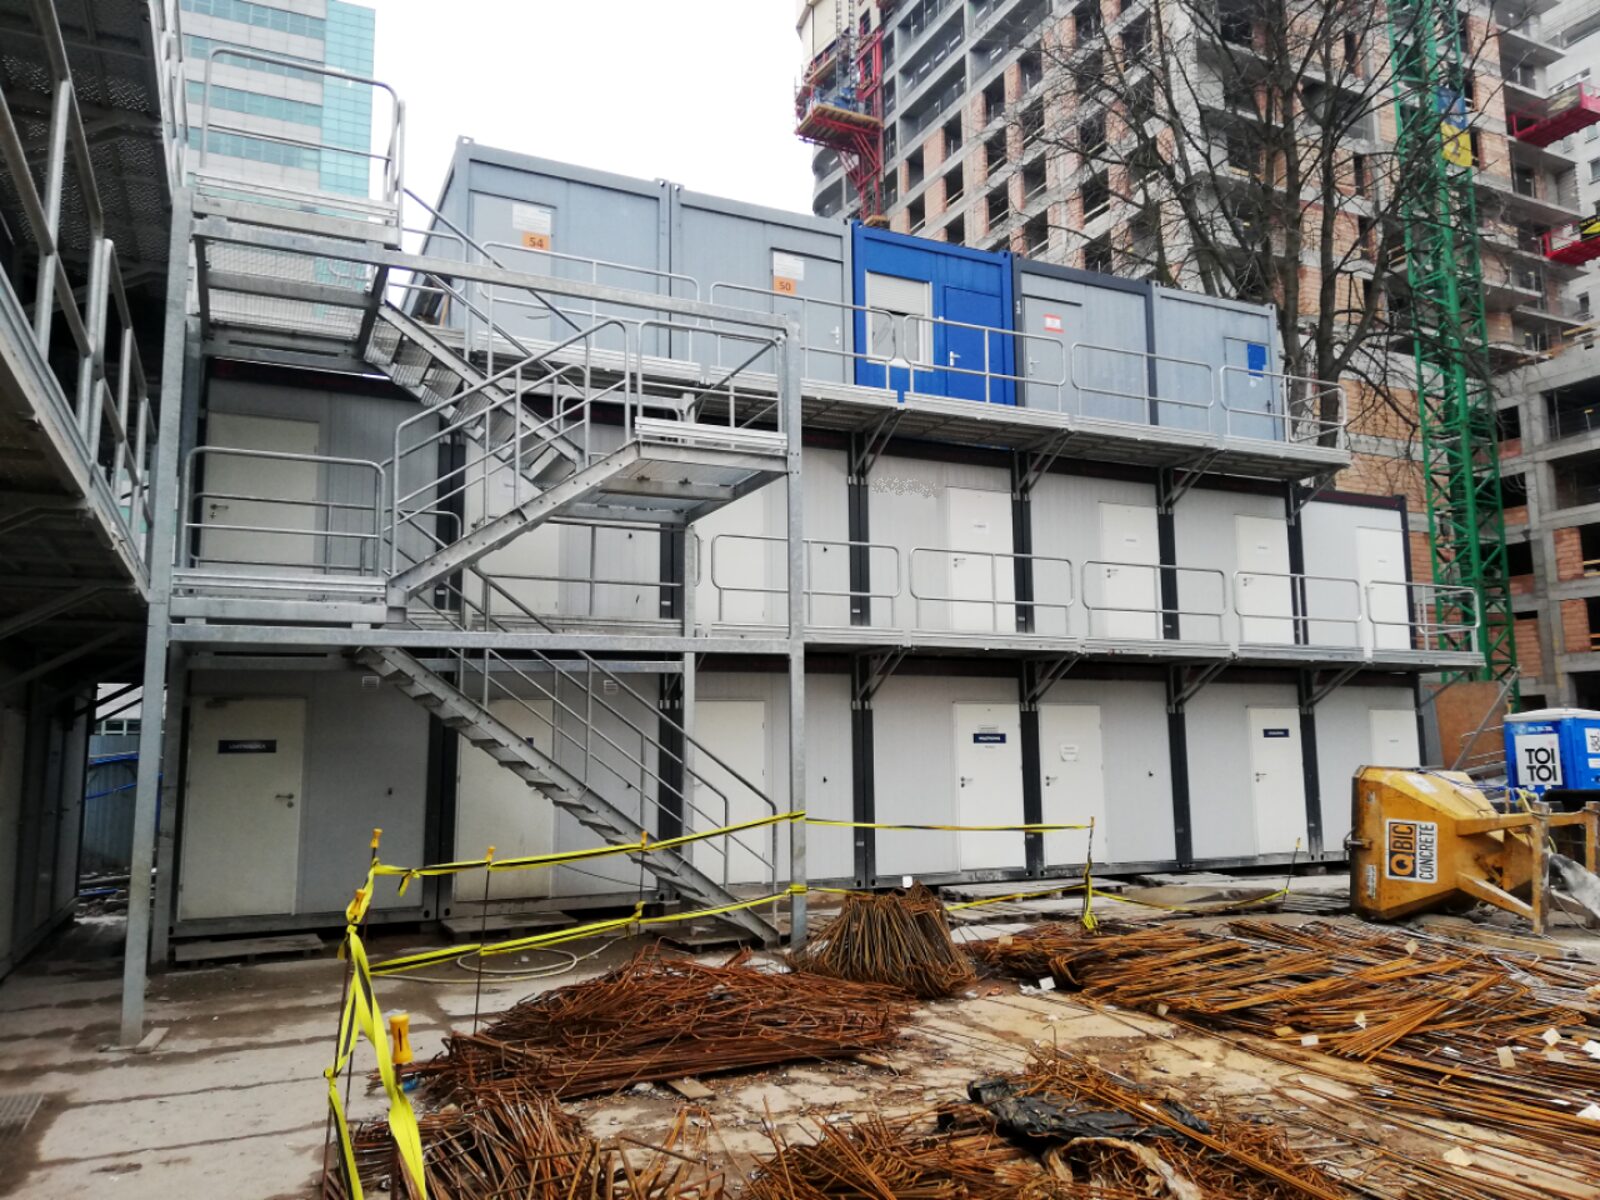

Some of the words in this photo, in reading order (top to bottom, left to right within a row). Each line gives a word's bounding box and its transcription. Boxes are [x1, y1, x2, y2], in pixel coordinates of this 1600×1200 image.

[529, 237, 544, 248] 54
[778, 281, 792, 291] 50
[1525, 747, 1555, 765] TOI
[1526, 764, 1557, 782] TOI
[1418, 823, 1435, 881] CONCRETE
